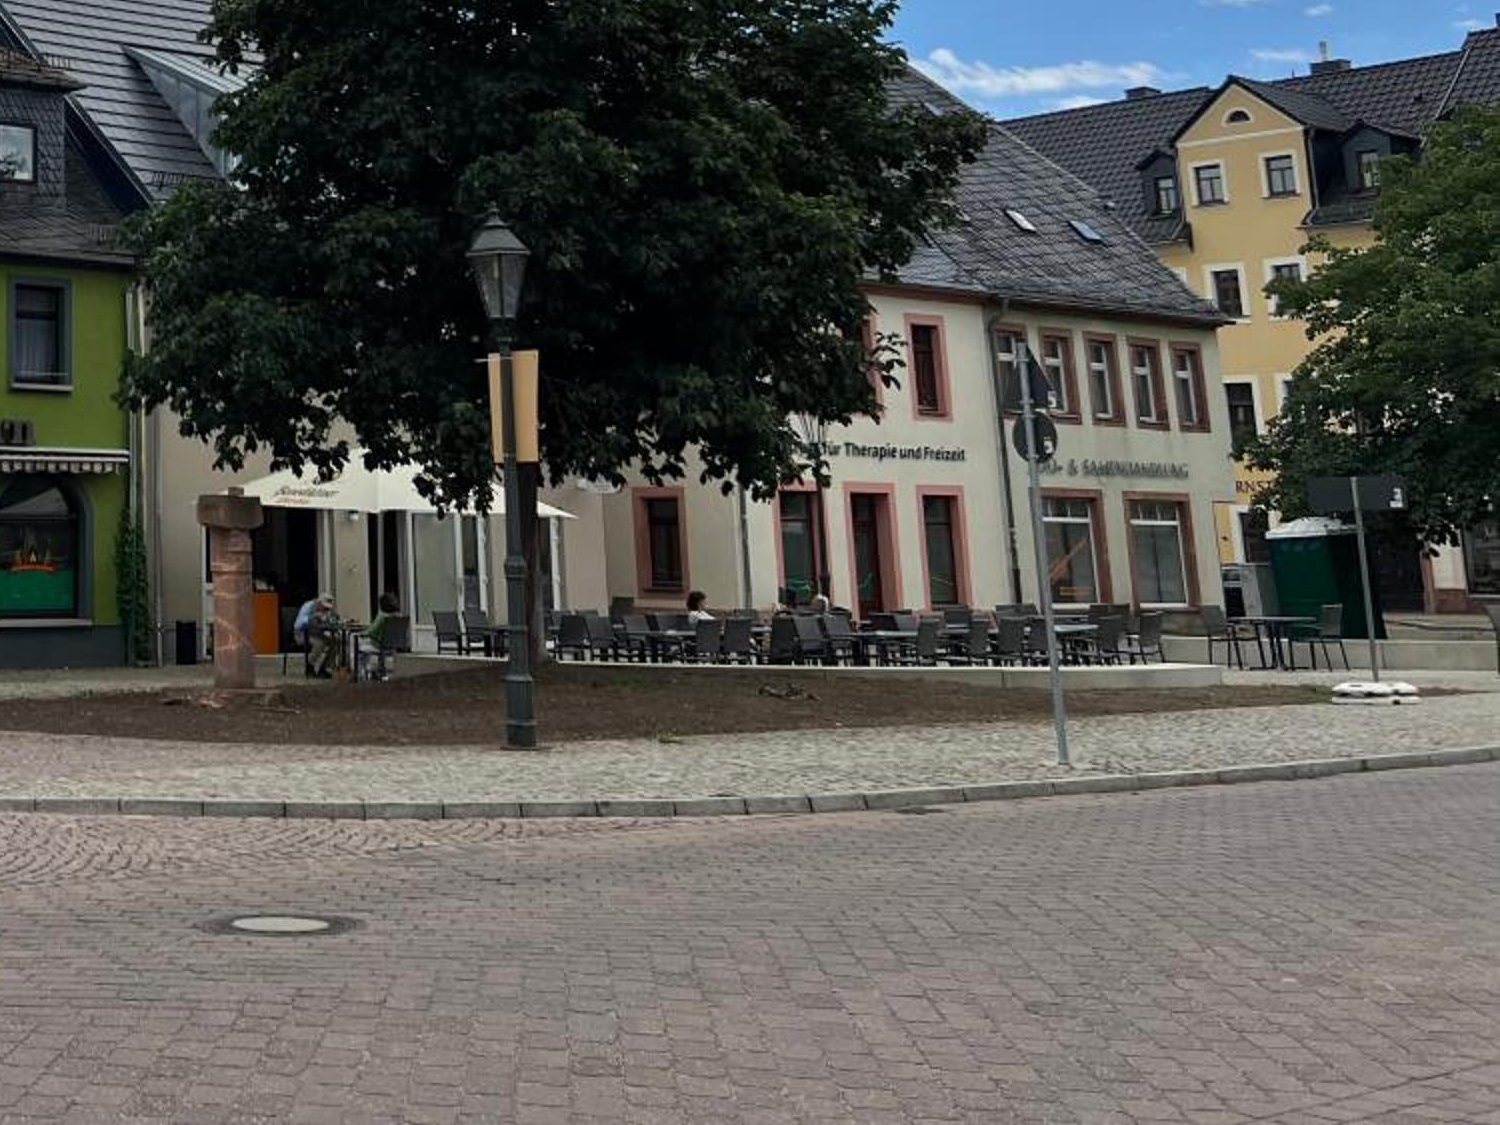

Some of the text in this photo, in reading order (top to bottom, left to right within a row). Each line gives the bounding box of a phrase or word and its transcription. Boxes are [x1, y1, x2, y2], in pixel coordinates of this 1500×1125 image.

[845, 442, 897, 462] Therapie
[900, 445, 923, 460] und
[924, 446, 966, 462] Freizeit
